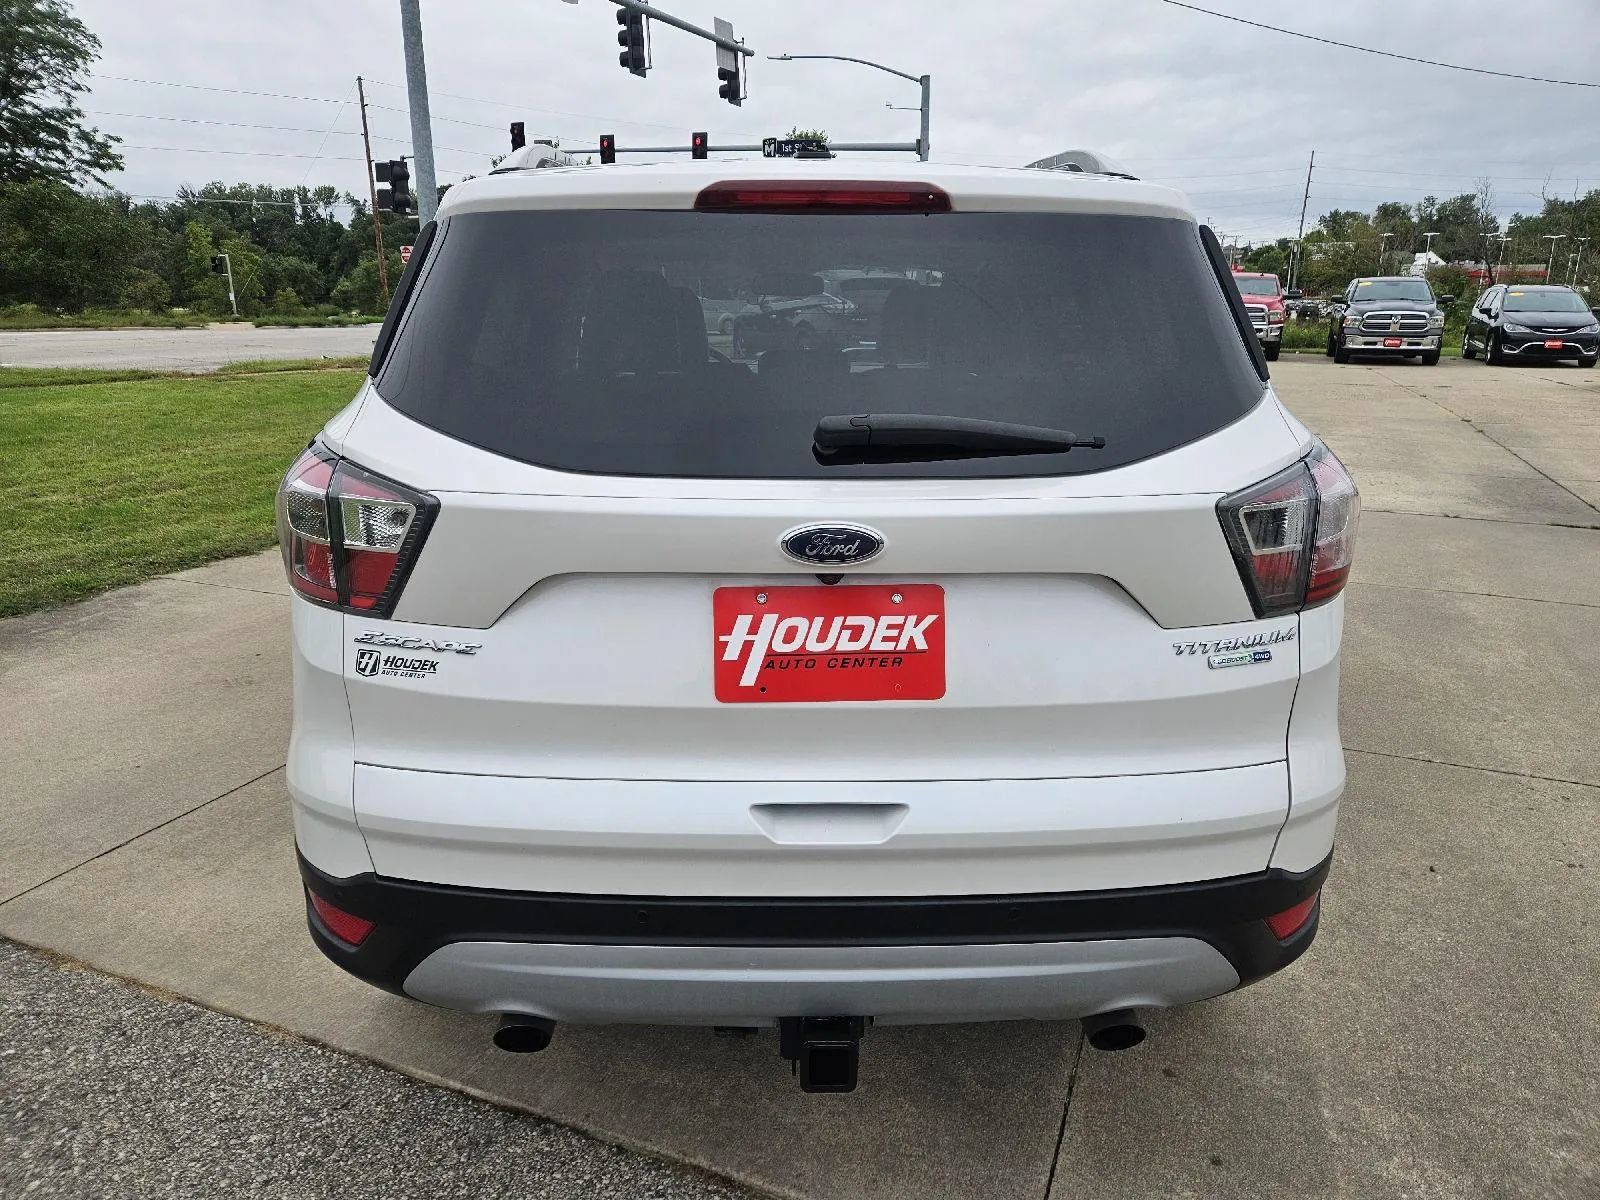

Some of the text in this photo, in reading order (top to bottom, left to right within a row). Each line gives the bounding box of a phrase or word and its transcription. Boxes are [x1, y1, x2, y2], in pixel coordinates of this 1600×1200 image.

[781, 143, 792, 152] 1st
[805, 533, 861, 557] Ford
[353, 629, 483, 655] ESCAPE
[1172, 625, 1297, 656] TITANIUM
[718, 613, 940, 687] HOUDEK
[1253, 652, 1271, 661] 4WD
[382, 655, 440, 672] HOUDEK
[764, 656, 904, 671] AUTO CENTER
[400, 671, 426, 679] CENTER
